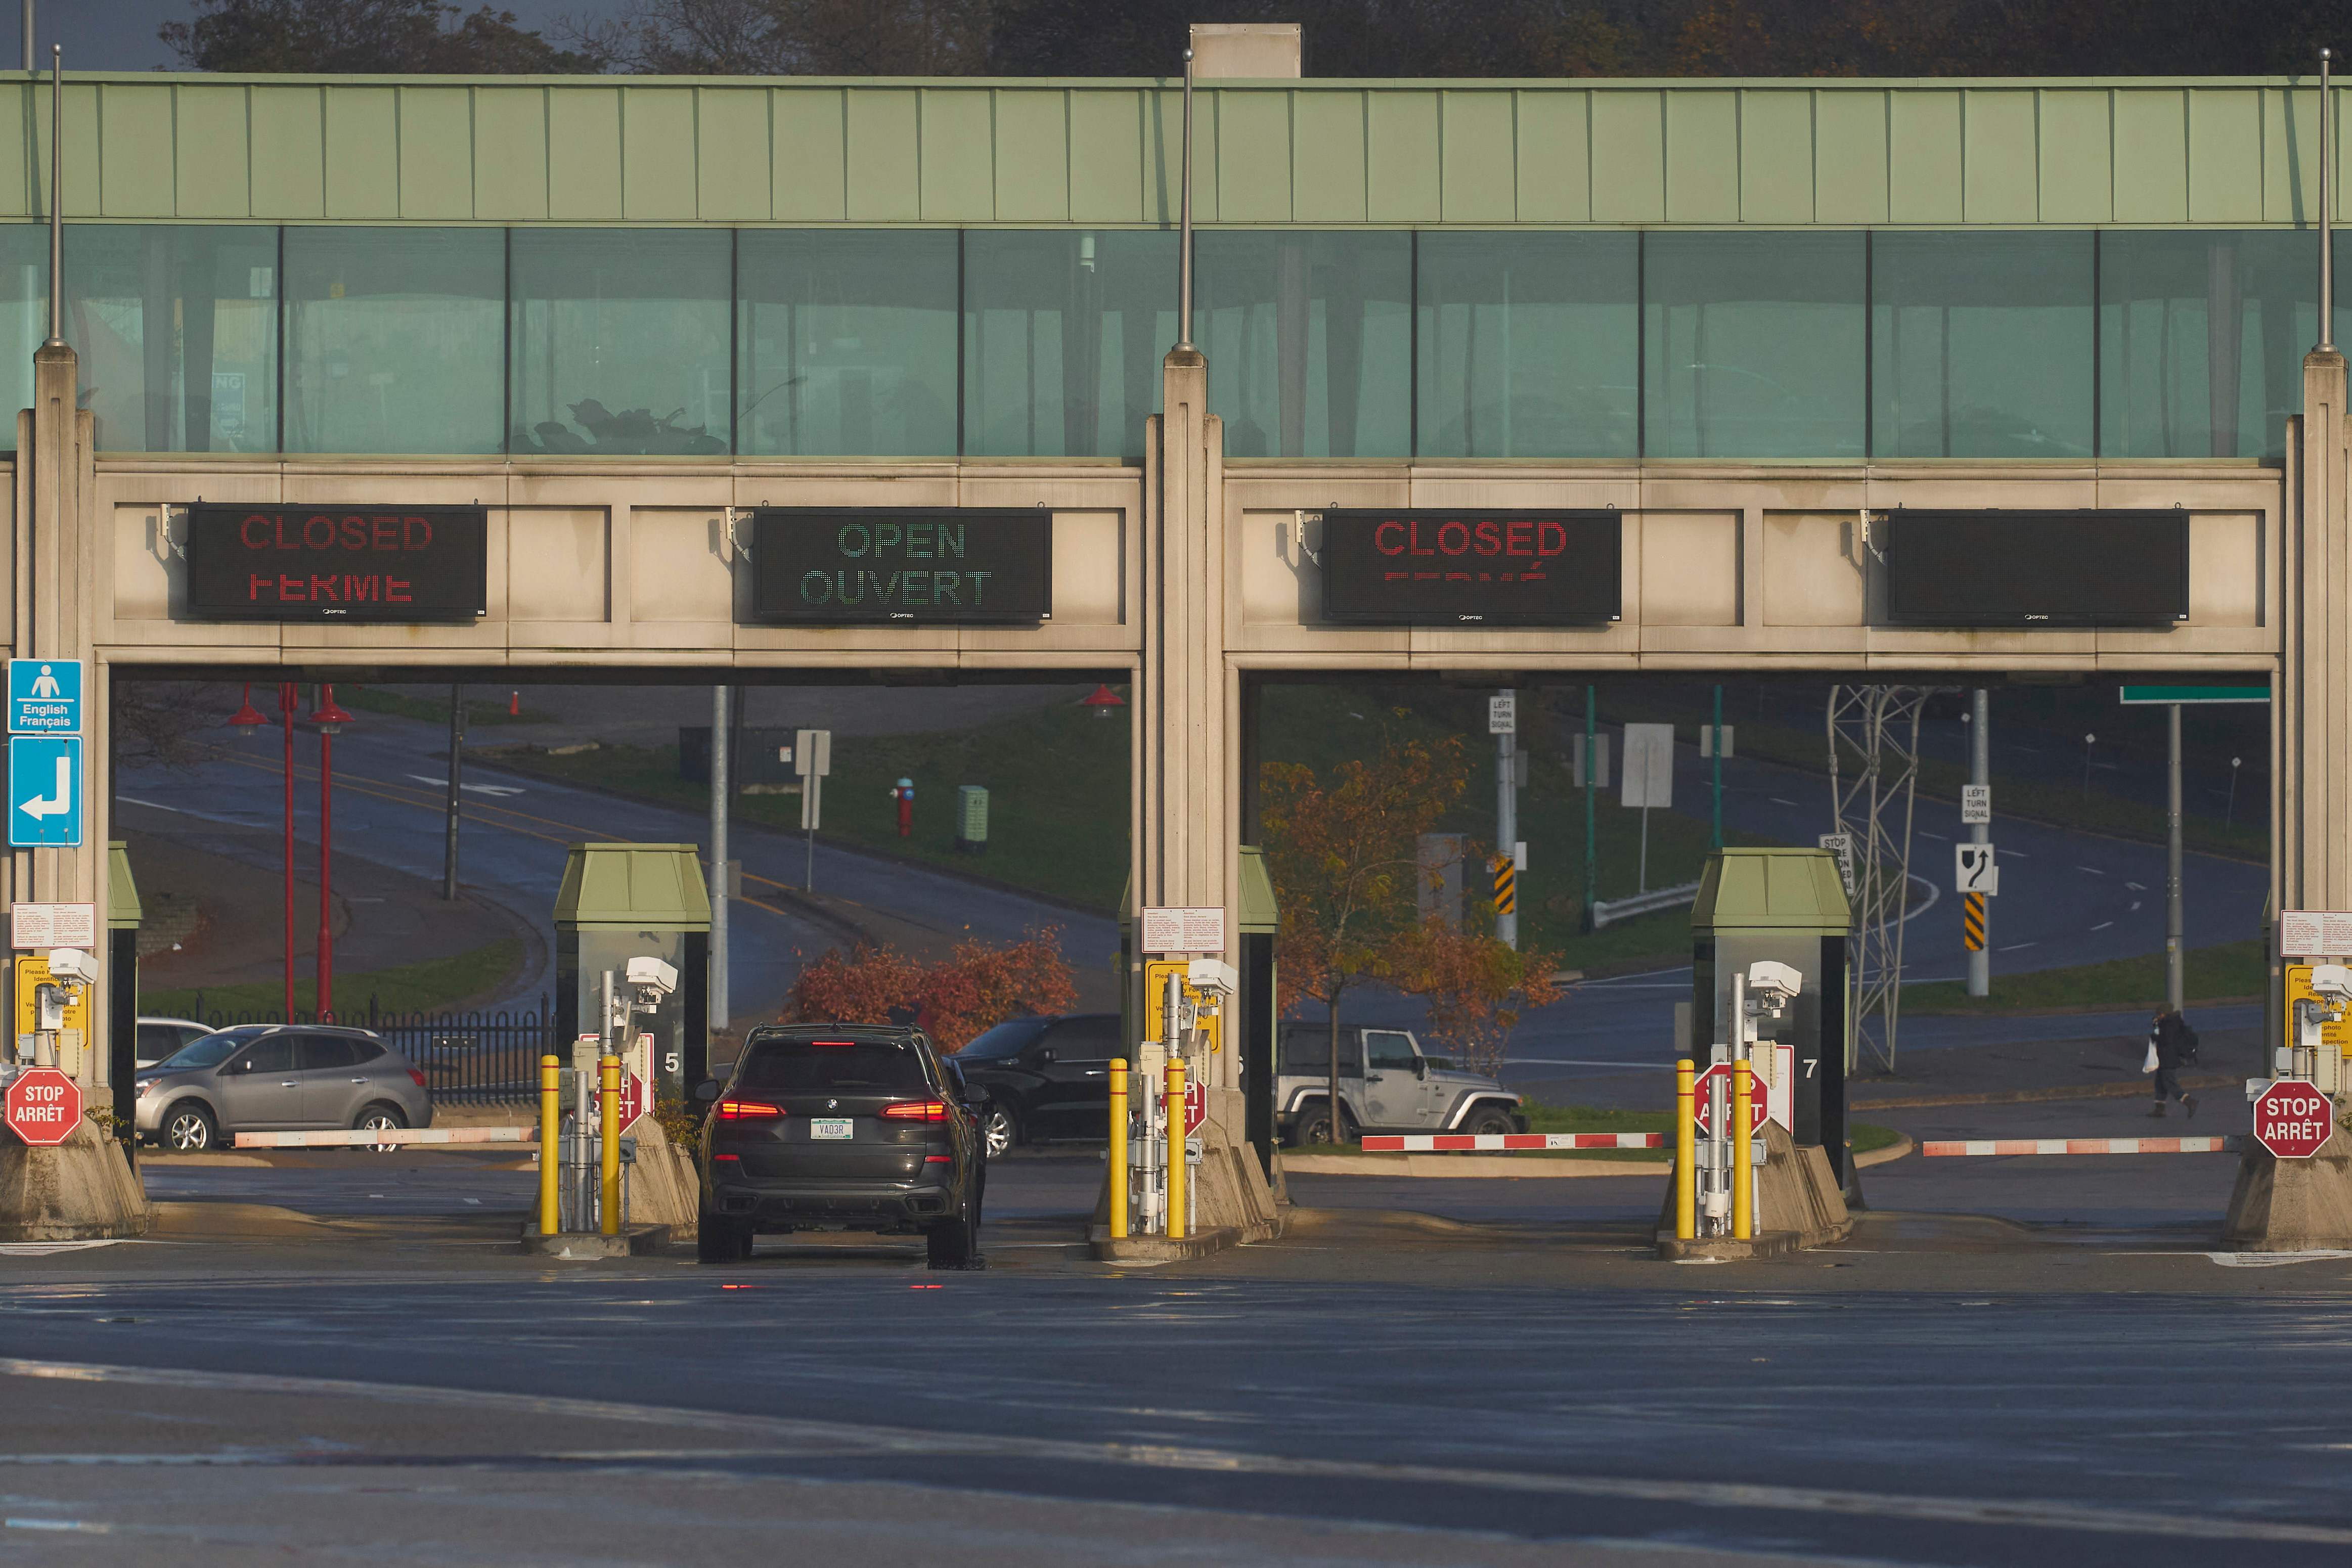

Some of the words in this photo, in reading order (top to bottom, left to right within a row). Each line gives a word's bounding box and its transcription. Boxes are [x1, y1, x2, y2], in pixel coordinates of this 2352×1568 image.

[241, 515, 432, 550] CLOSED
[838, 523, 964, 557] OPEN
[1375, 521, 1566, 556] CLOSED
[801, 571, 991, 605] OUVERT
[23, 704, 67, 716] English
[20, 716, 71, 728] Français
[1825, 838, 1846, 849] STOP
[664, 1052, 679, 1072] 5
[1803, 1059, 1817, 1079] 7
[25, 1086, 64, 1101] STOP
[16, 1103, 65, 1122] ARRÊT
[2267, 1098, 2321, 1116] STOP
[820, 1125, 844, 1134] VAD3R
[2265, 1118, 2323, 1140] ARRÊT
